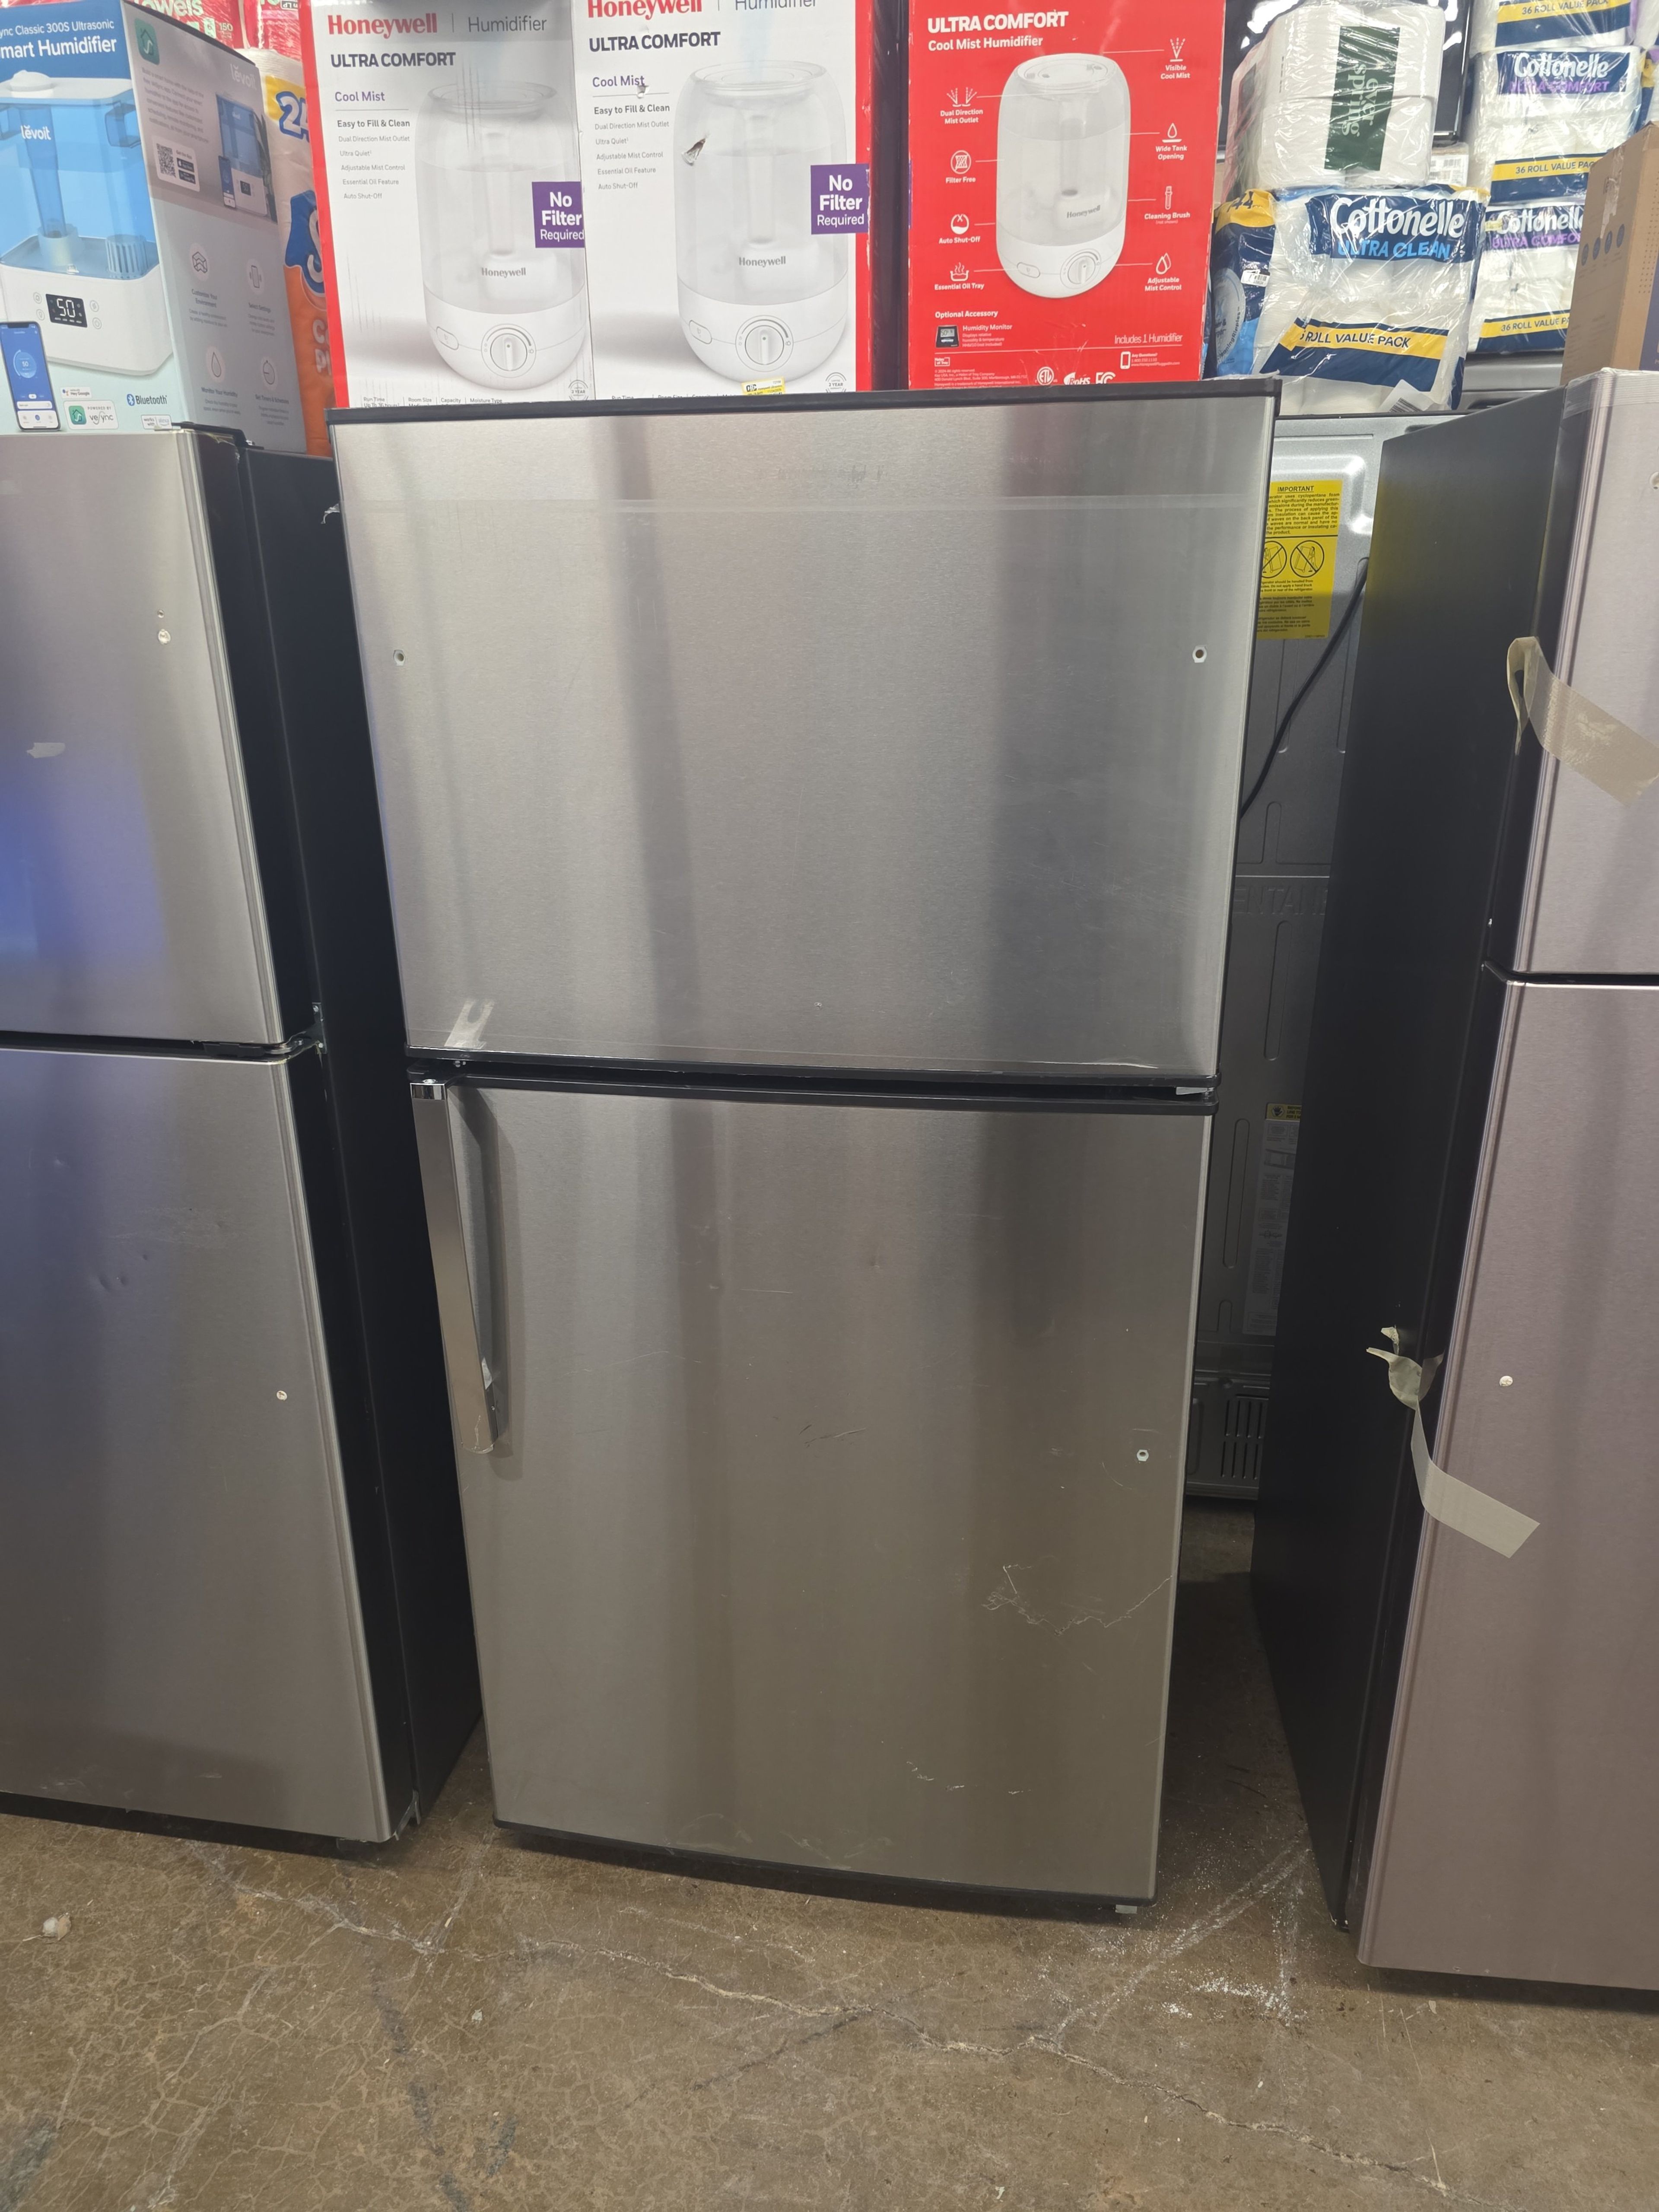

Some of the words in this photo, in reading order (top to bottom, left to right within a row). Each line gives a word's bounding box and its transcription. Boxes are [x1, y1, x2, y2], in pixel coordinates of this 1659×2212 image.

[588, 0, 702, 20] Honeywell
[16, 24, 44, 35] Classic
[47, 22, 70, 33] 300S
[72, 19, 114, 32] Ultrasonic
[219, 22, 233, 31] 150
[328, 13, 437, 39] Honeywell
[469, 16, 547, 32] Humidifier
[928, 16, 982, 33] ULTRA
[983, 11, 1069, 30] COMFORT
[0, 42, 35, 59] mart
[38, 35, 117, 56] Humidifier
[589, 35, 639, 52] ULTRA
[641, 31, 721, 49] COMFORT
[928, 40, 953, 51] Cool
[957, 38, 981, 49] Mist
[984, 35, 1043, 48] Humidifier
[331, 54, 379, 67] ULTRA
[381, 52, 456, 67] COMFORT
[1514, 52, 1609, 78] Cottonelle
[592, 76, 617, 87] Cool
[620, 75, 645, 86] Mist
[335, 92, 359, 102] Cool
[362, 92, 385, 101] Mist
[594, 107, 612, 116] Easy
[337, 120, 355, 129] Easy
[1551, 162, 1575, 170] VALUE
[830, 175, 852, 191] No
[550, 192, 572, 207] No
[820, 194, 862, 211] Filter
[542, 210, 582, 226] Filter
[817, 213, 864, 228] Required
[1330, 197, 1465, 238] Cottonelle
[540, 229, 584, 242] Required
[1393, 241, 1451, 259] CLEAN
[739, 256, 785, 267] Honeywell
[481, 267, 526, 279] Honeywell
[57, 298, 76, 318] 50
[1535, 318, 1560, 327] VALUE
[1114, 335, 1141, 344] Includes
[1142, 335, 1147, 343] 1
[1149, 333, 1183, 343] Humidifier
[1335, 334, 1375, 343] VALUE
[1378, 336, 1411, 348] PACK
[135, 394, 167, 405] Bluetooth
